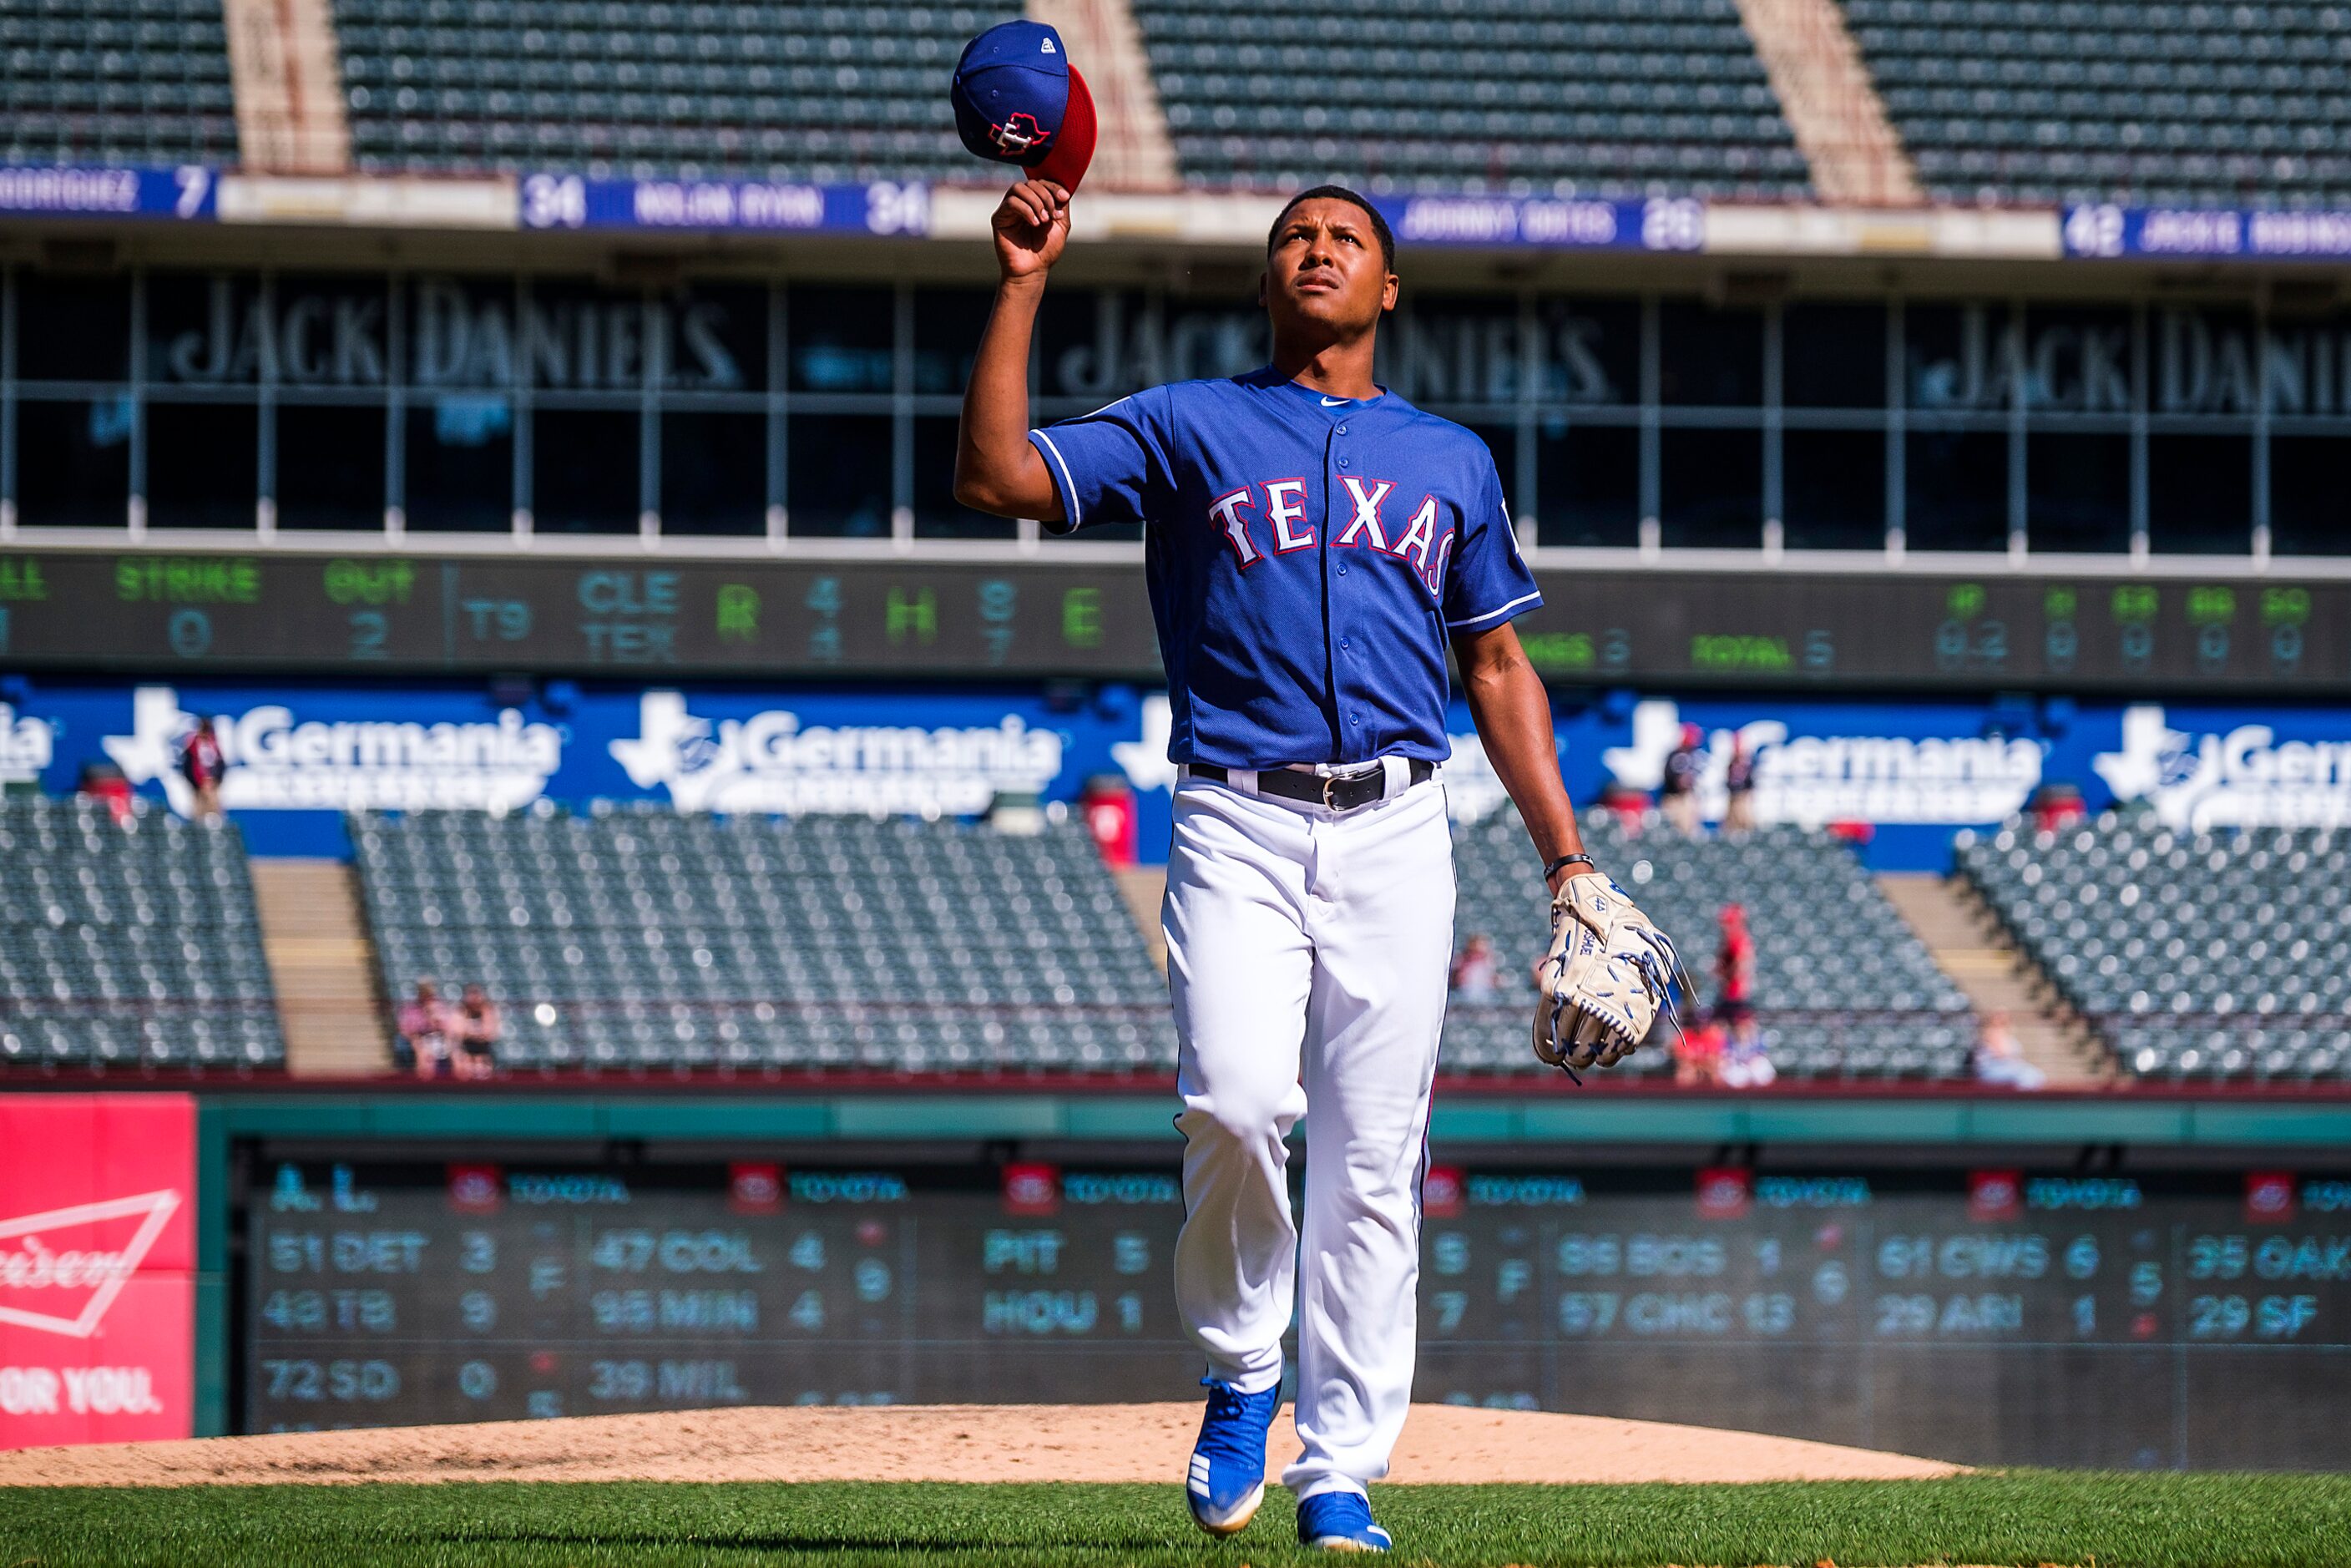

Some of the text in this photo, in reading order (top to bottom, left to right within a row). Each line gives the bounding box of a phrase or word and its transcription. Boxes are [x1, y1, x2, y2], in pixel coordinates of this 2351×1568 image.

[0, 165, 210, 220] ODRIGUEZ 7
[524, 174, 586, 228] 34
[867, 180, 930, 235] 34
[2247, 211, 2351, 254] ROBINS
[171, 276, 386, 382] JACK
[115, 558, 260, 604] STRIKE
[324, 559, 415, 604] OUT
[578, 569, 679, 614] CLE
[715, 584, 759, 641] R
[885, 586, 937, 645] H
[1061, 587, 1104, 650] E
[579, 621, 678, 665] TEX
[1691, 632, 1797, 673] TOTAL
[234, 703, 564, 776] Germania
[738, 708, 1064, 783] Germania
[509, 1173, 631, 1205] TOYOTA
[788, 1173, 910, 1205] TOYOTA
[1467, 1175, 1586, 1204] TOYOTA
[1753, 1176, 1872, 1206] TOYOTA
[2024, 1176, 2144, 1209] TOYOTA
[332, 1231, 429, 1274] DET
[461, 1232, 498, 1275] 3
[658, 1227, 765, 1273] COL
[788, 1229, 827, 1272] 4
[983, 1227, 1067, 1276] PIT
[1625, 1232, 1726, 1277] BOS
[1937, 1233, 2050, 1279] CWS
[331, 1289, 397, 1333] TB
[659, 1289, 760, 1334] MIN
[788, 1290, 826, 1333] 4
[982, 1289, 1144, 1336] HOU 1
[1429, 1291, 1469, 1336] 7
[1624, 1290, 1735, 1336] CHC
[1939, 1294, 2024, 1334] ARI
[2070, 1293, 2097, 1338] 1
[2254, 1294, 2318, 1338] SF
[0, 1366, 164, 1416] OR YOU.
[261, 1358, 498, 1401] 72 SD 0
[656, 1358, 750, 1403] MIL
